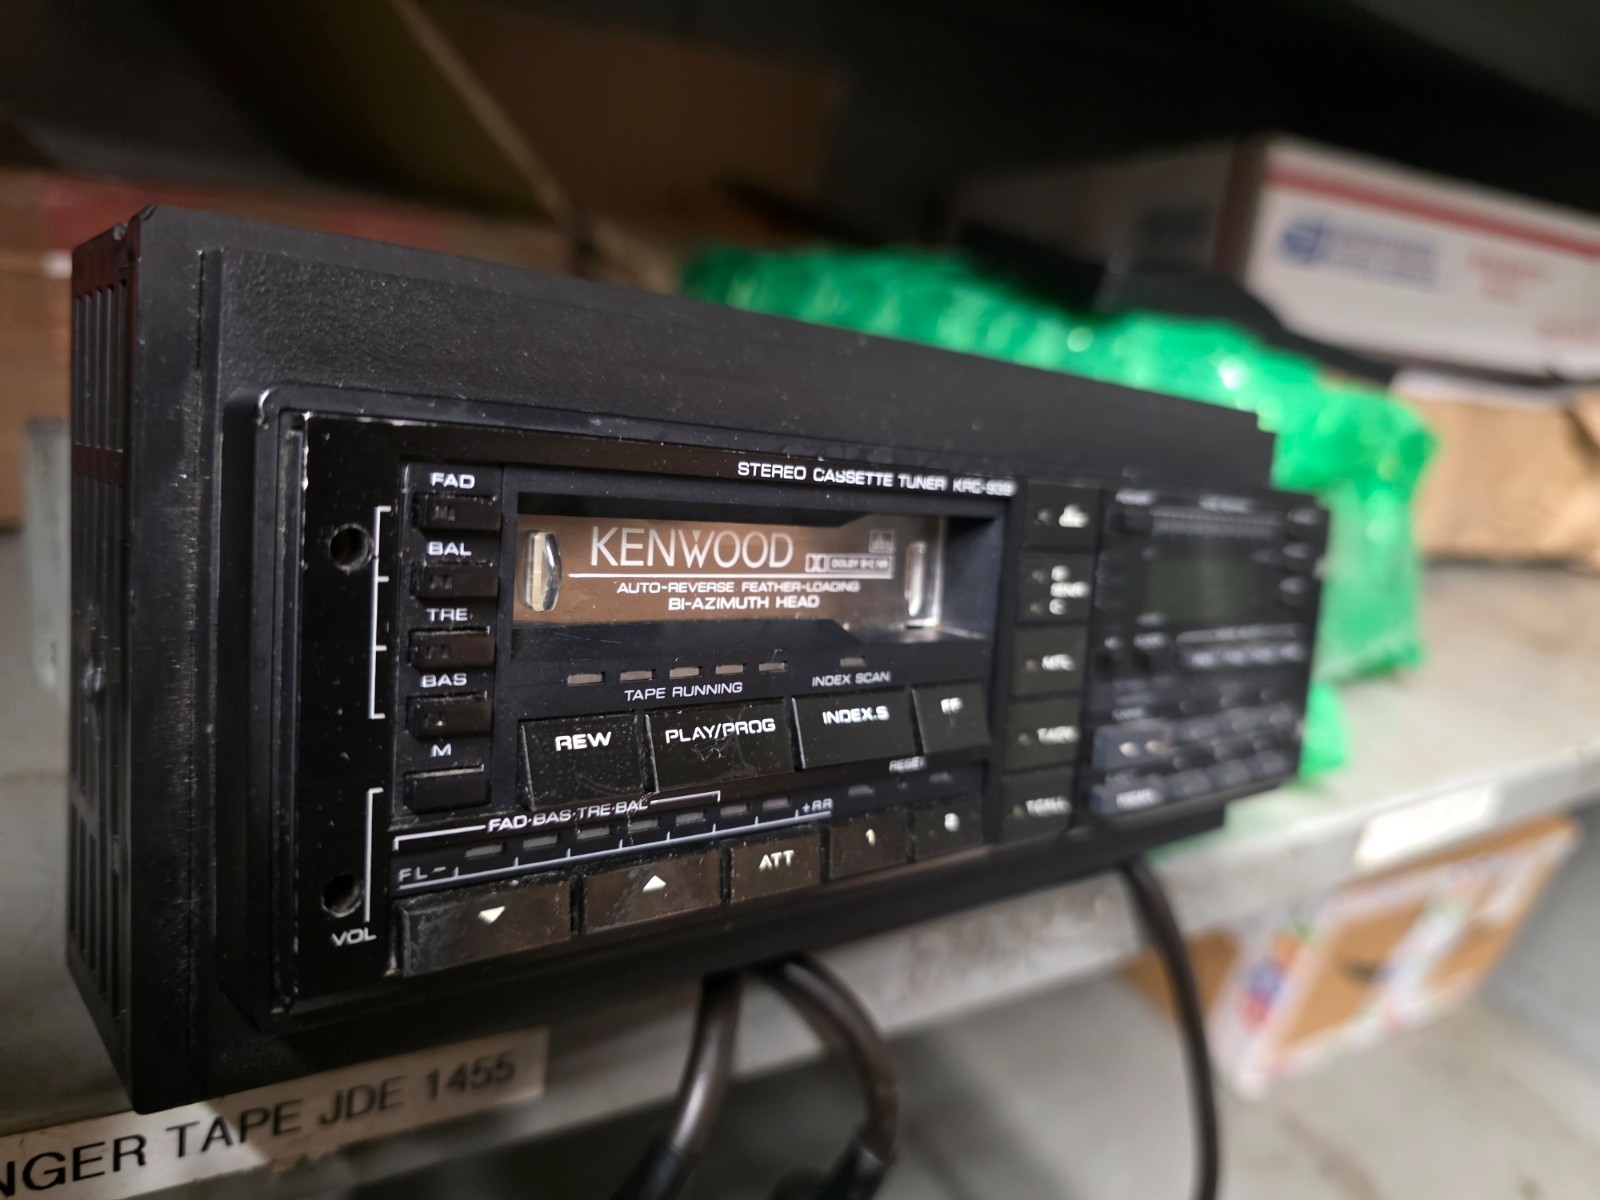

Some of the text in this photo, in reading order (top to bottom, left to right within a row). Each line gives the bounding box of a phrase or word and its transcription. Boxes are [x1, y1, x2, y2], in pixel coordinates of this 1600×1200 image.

[431, 472, 476, 489] FAD
[737, 462, 807, 481] STEREO
[813, 468, 893, 488] CASSETTE
[899, 475, 948, 492] TUNER
[427, 542, 472, 557] BAL
[591, 526, 794, 568] KENWOOD
[616, 581, 862, 595] AUTO-REVERSE FEATHER-LOADING
[667, 595, 821, 611] BI-AZIMUTH HEAD
[426, 608, 468, 622] TRE
[420, 673, 467, 689] BAS
[811, 671, 891, 688] INDEX SCAN
[624, 681, 743, 702] TAPE RUNNING
[823, 705, 890, 725] INDEX.S
[664, 716, 776, 744] PLAY/PROG
[430, 743, 452, 758] M
[554, 731, 612, 752] REW
[758, 849, 794, 869] ATT
[331, 927, 376, 947] VOL
[165, 1099, 303, 1159] TAPE
[319, 1075, 405, 1126] JDE
[424, 1051, 517, 1099] 1455
